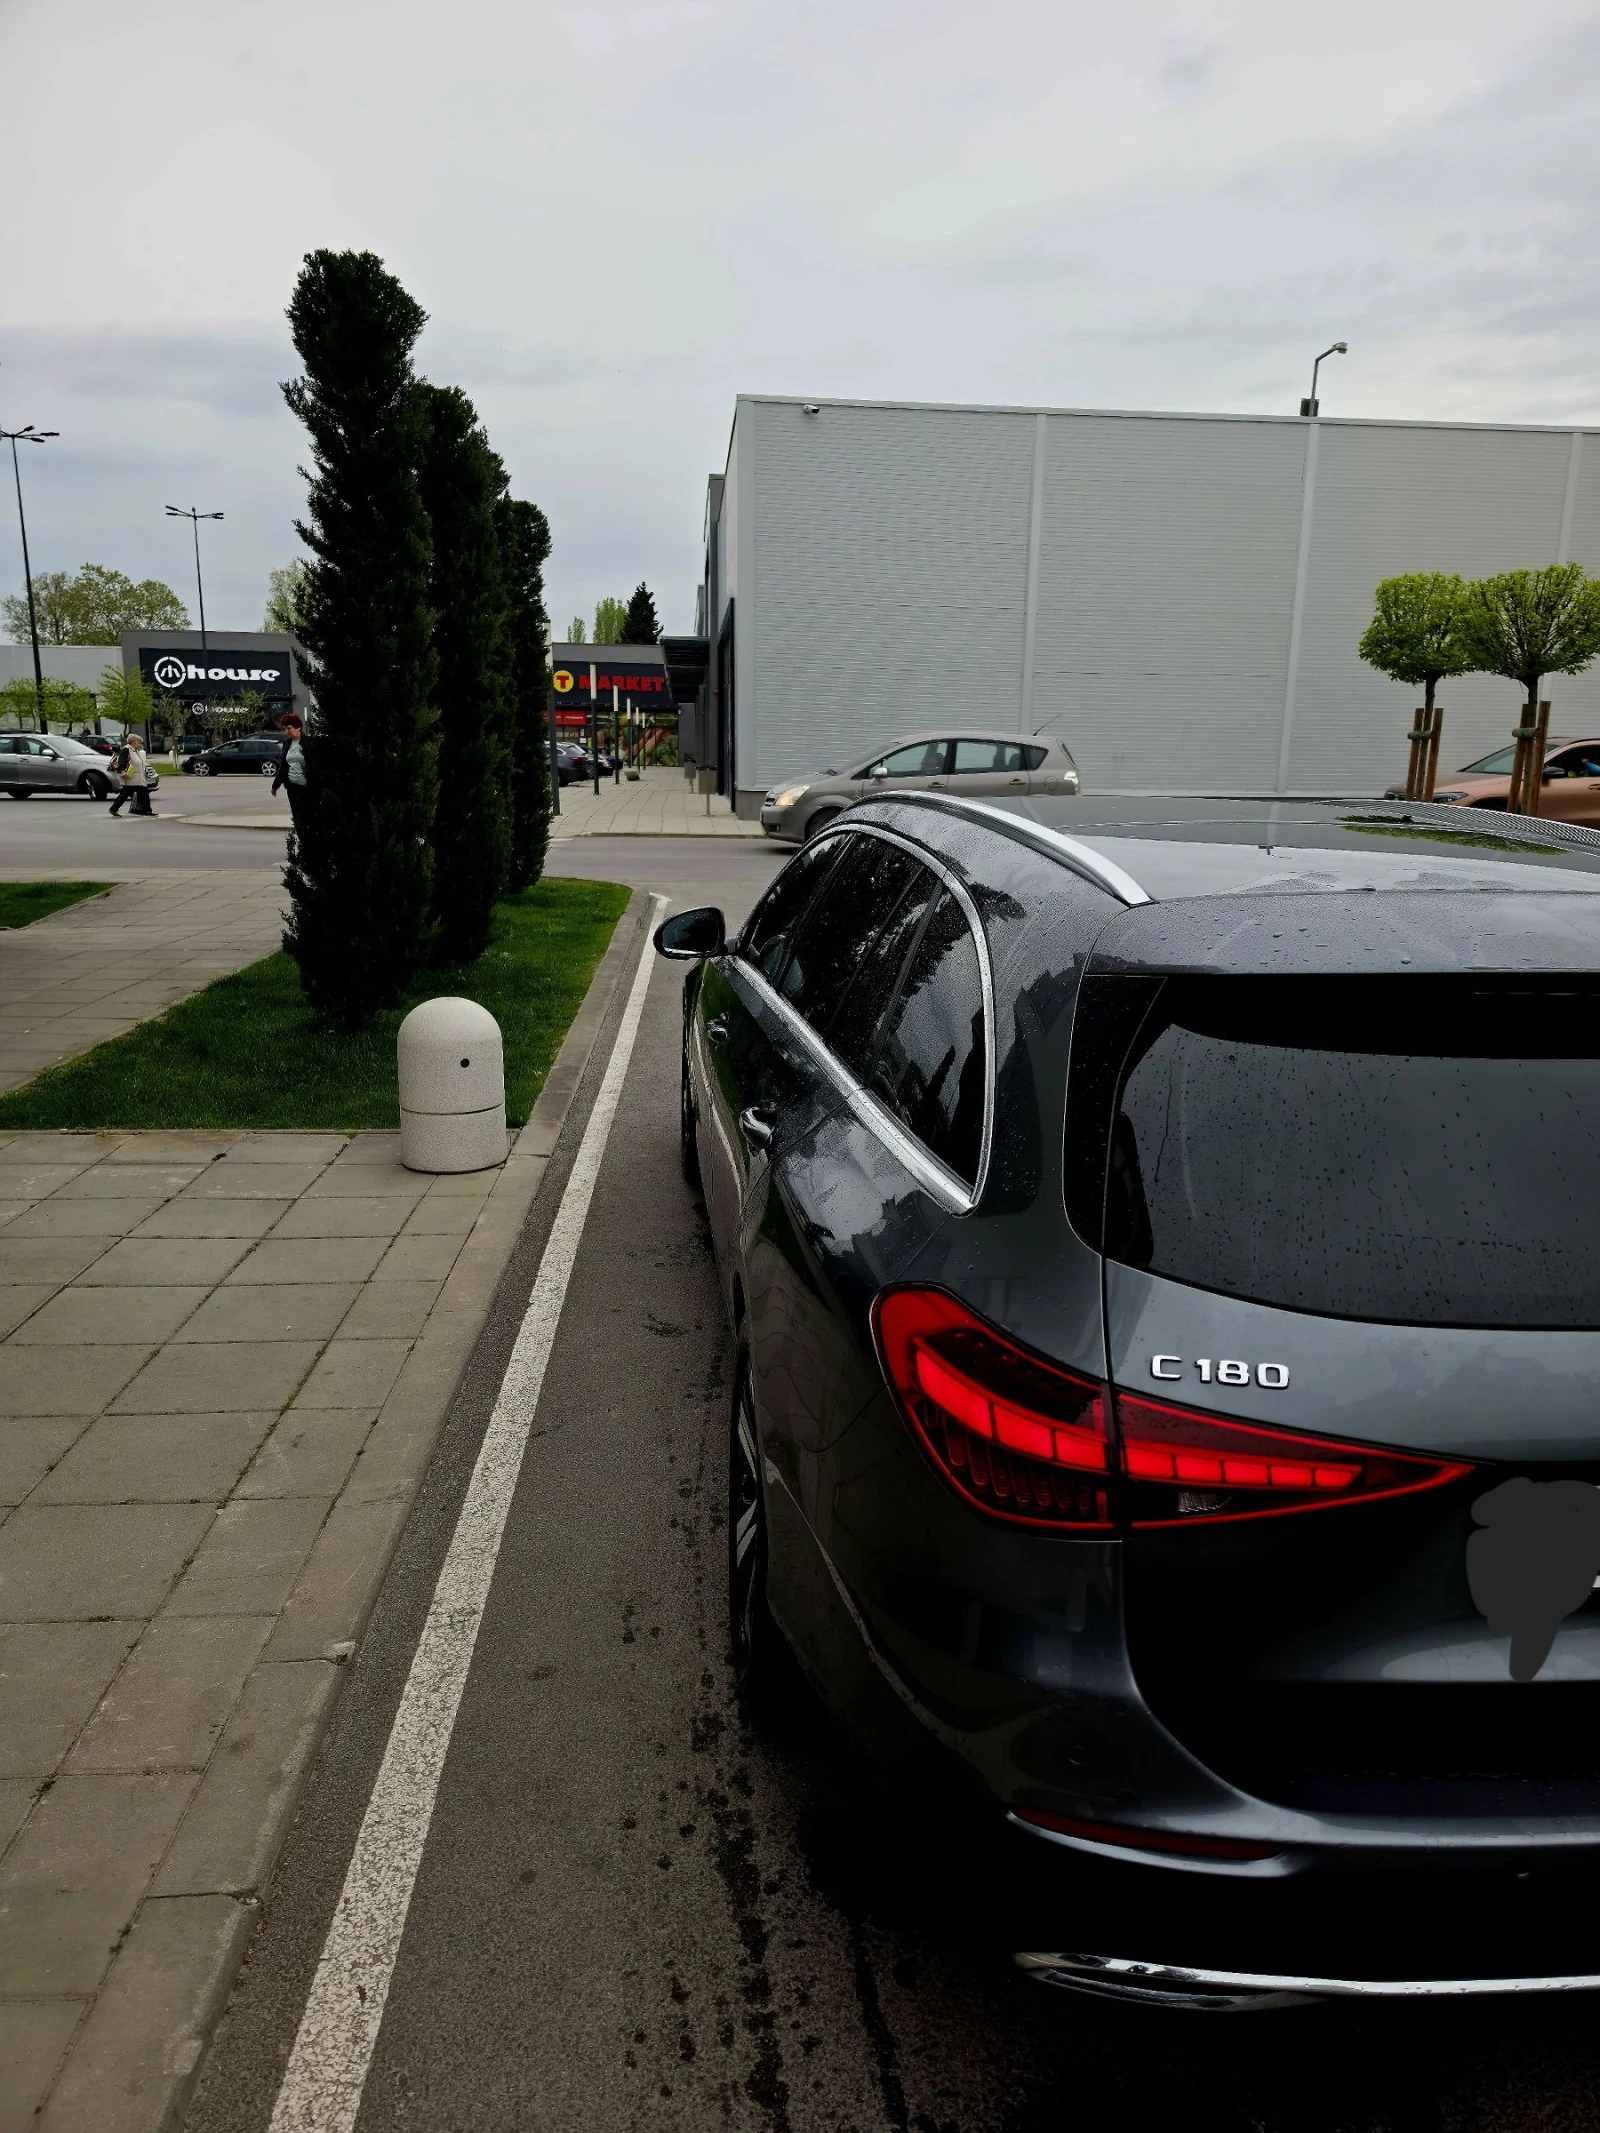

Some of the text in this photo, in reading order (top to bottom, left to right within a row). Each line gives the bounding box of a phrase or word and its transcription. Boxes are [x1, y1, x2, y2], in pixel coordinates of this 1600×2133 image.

[187, 664, 281, 682] house
[556, 674, 665, 692] T MARKET
[1151, 1354, 1290, 1390] C 180
